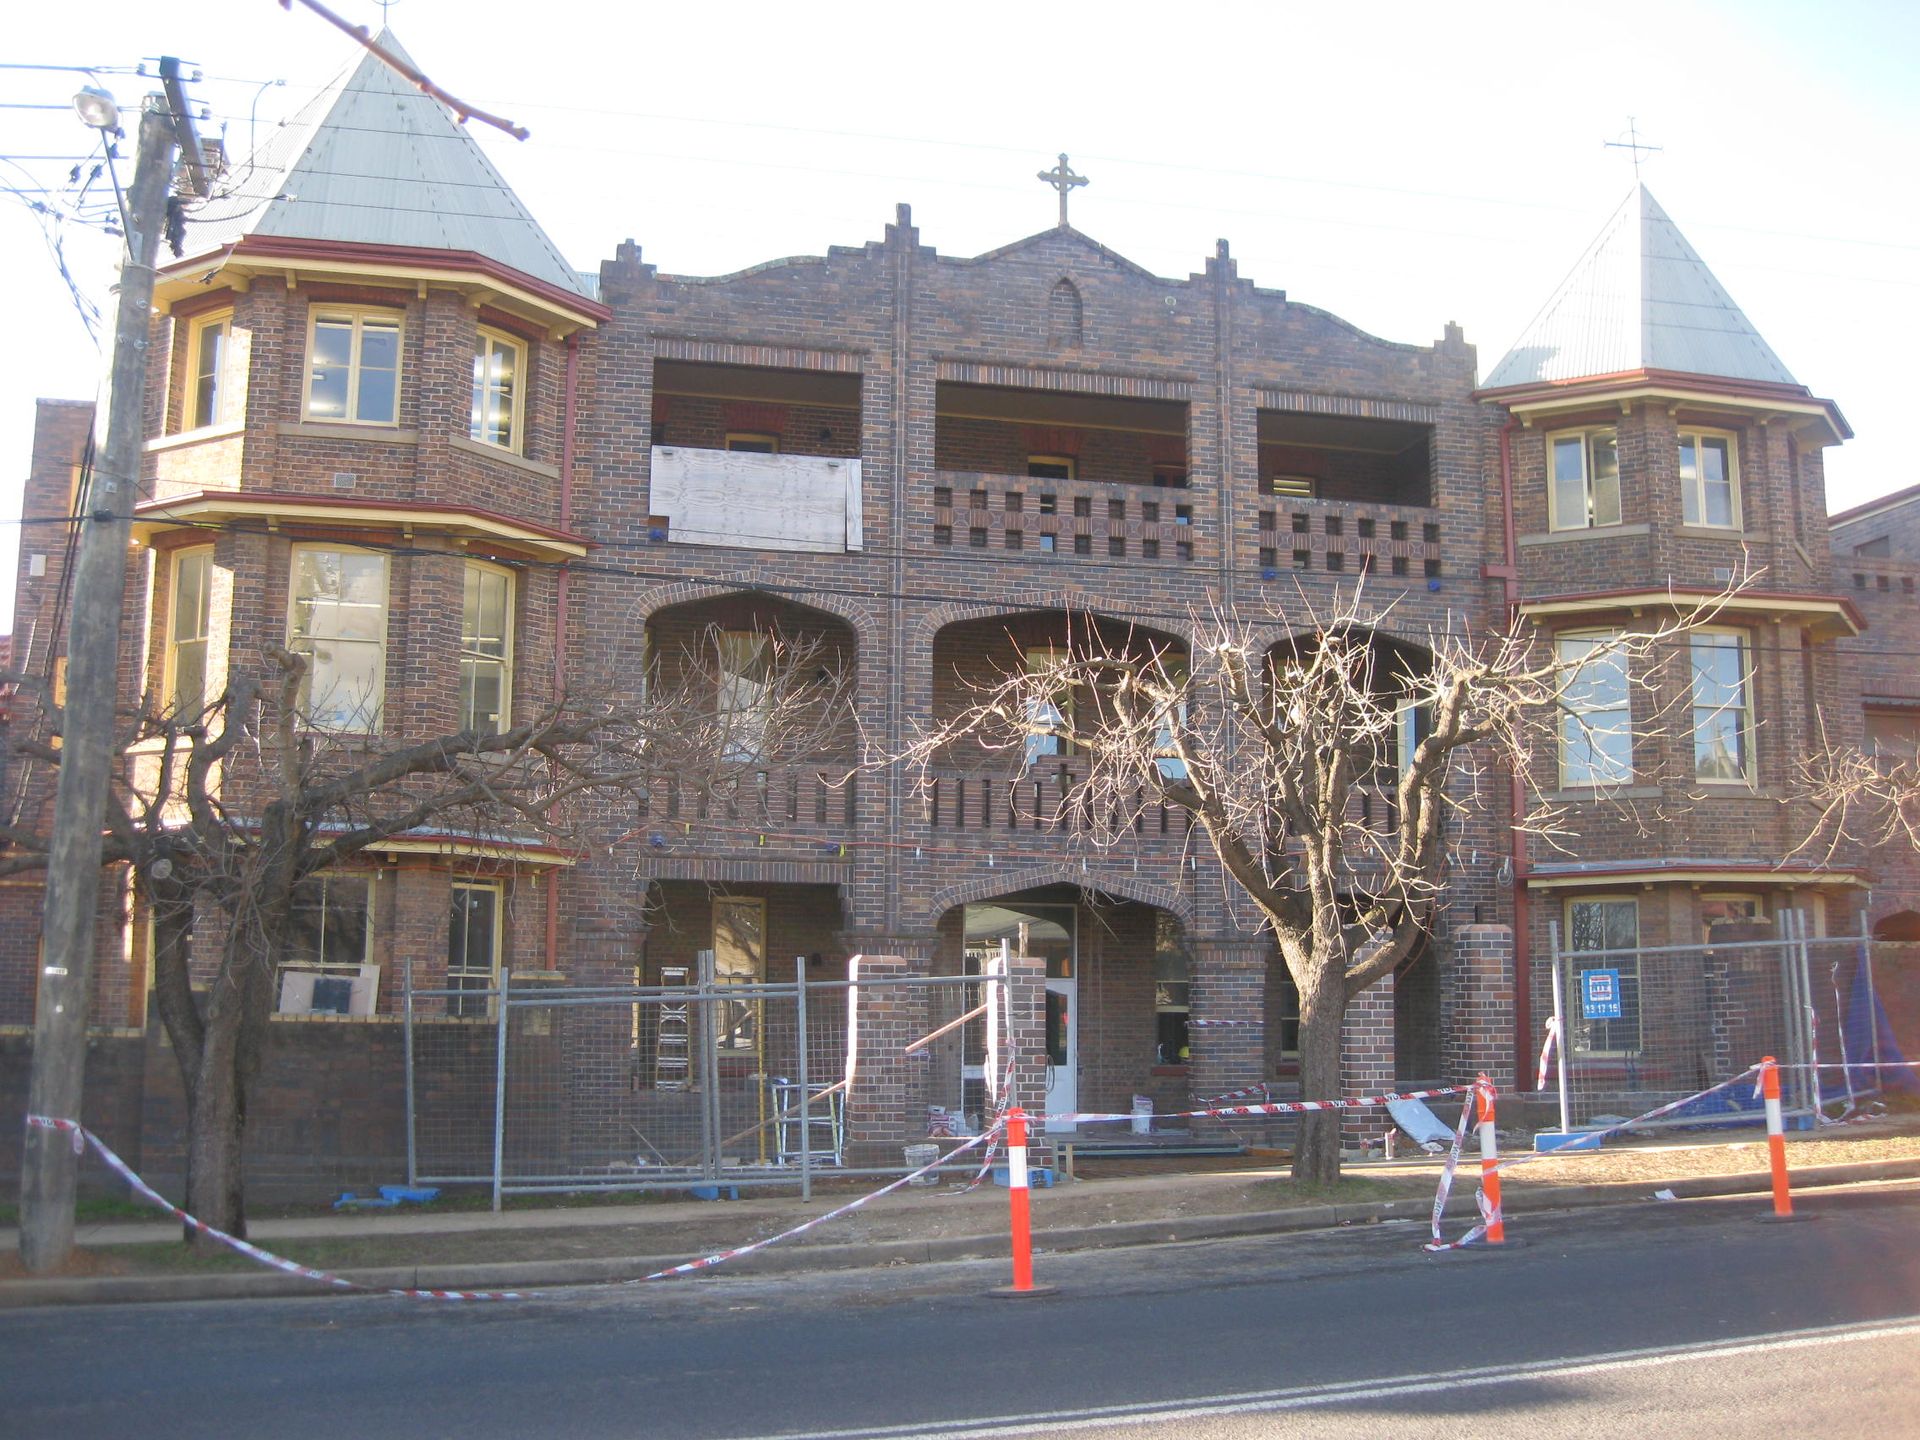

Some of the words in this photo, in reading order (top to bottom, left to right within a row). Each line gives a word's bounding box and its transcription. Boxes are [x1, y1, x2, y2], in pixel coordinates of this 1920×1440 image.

[1585, 1004, 1595, 1014] 13
[1598, 1003, 1606, 1014] 17
[1267, 1104, 1303, 1113] DANGER
